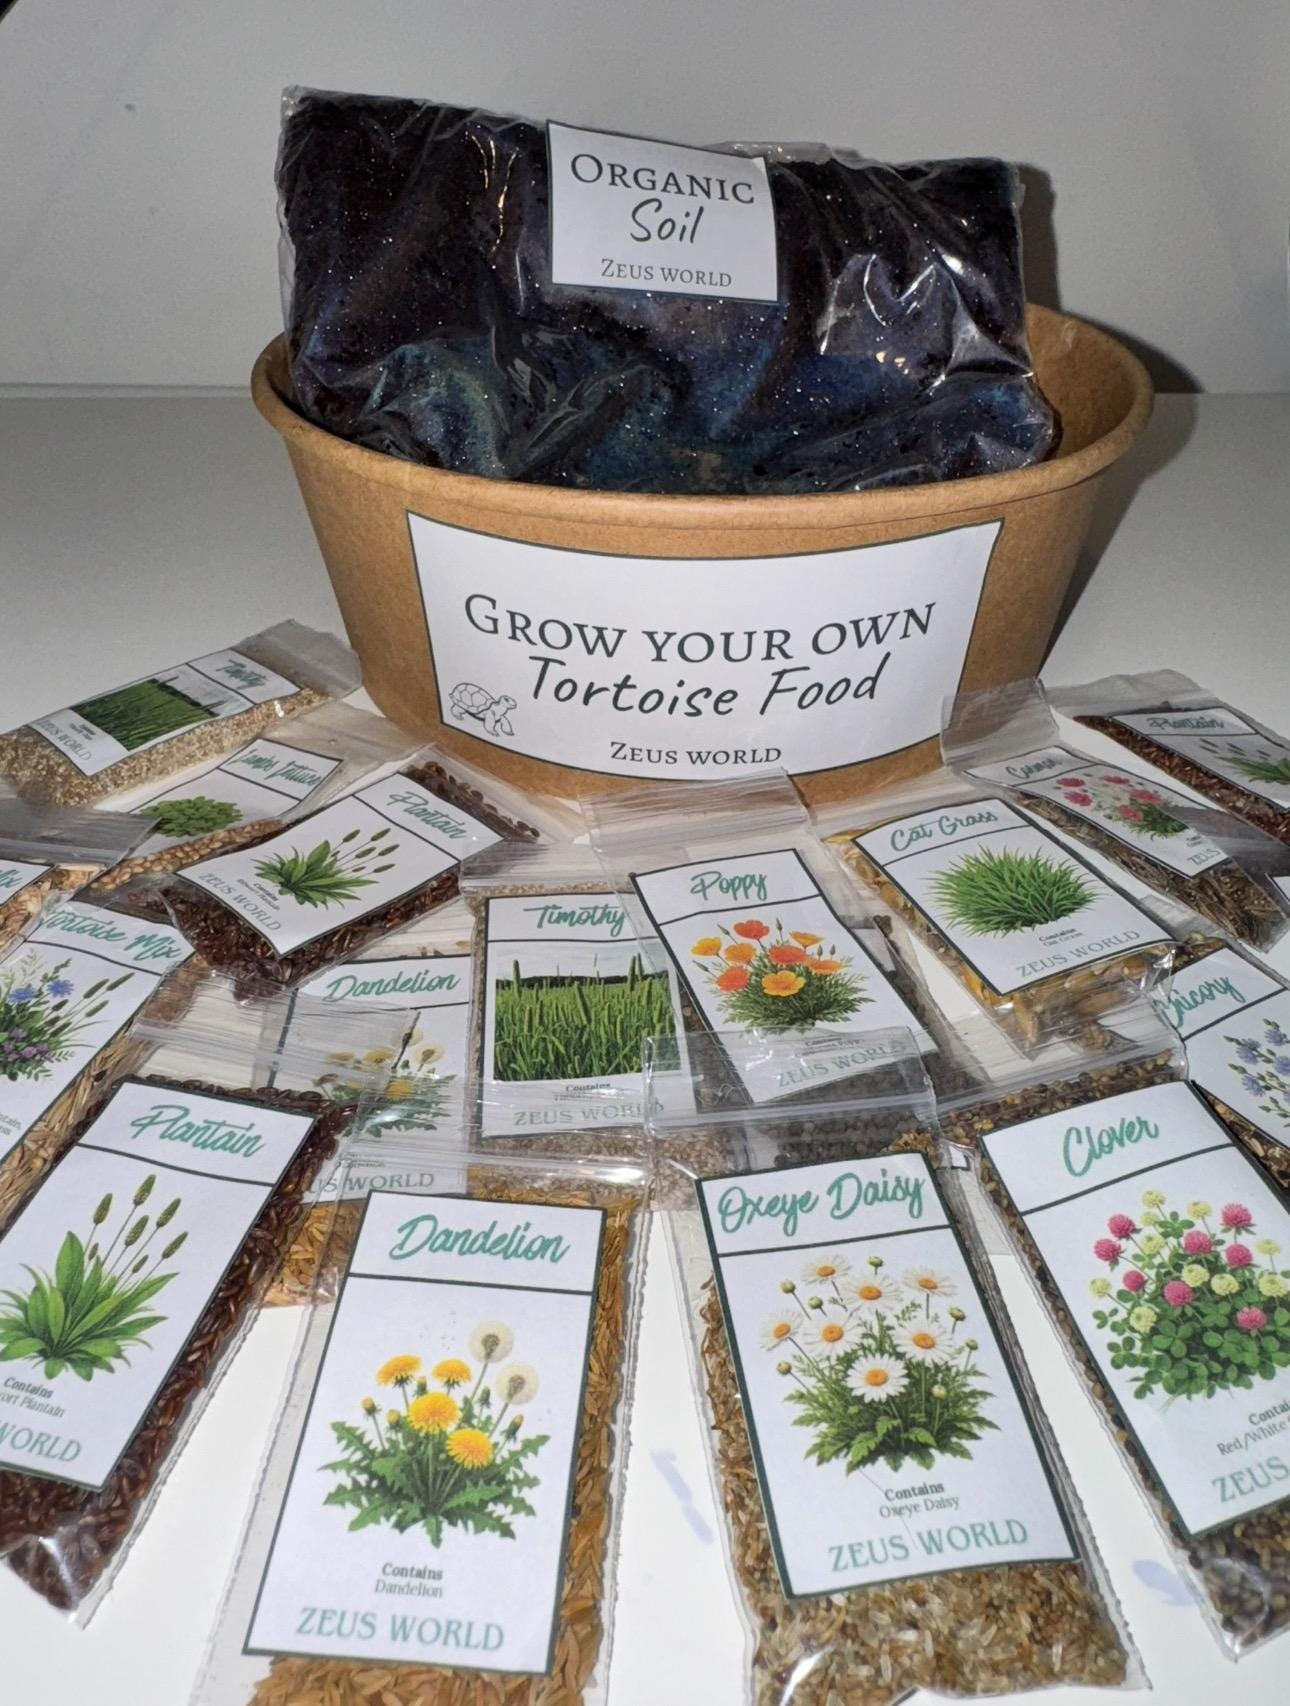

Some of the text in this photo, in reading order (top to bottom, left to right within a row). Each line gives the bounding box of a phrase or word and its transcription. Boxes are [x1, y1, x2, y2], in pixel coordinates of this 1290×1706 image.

[571, 153, 754, 204] ORGANIC
[630, 198, 704, 244] Soil
[601, 258, 732, 288] ZEUS WORLD
[464, 594, 936, 663] GROW YOUR OWN
[528, 651, 891, 717] Tortoise Food
[610, 741, 782, 766] ZEUS WORLD
[386, 791, 467, 838] Plantain
[890, 811, 998, 851] Cat Grass
[199, 873, 281, 930] ZEUS WORLD
[690, 871, 767, 900] Poppy
[523, 904, 627, 937] Timothy
[124, 933, 182, 961] Mix
[1016, 954, 1068, 978] ZEUS
[1069, 930, 1140, 958] WORLD
[323, 968, 461, 1002] Dandelion
[778, 1063, 829, 1087] ZEUS
[130, 1104, 266, 1158] Plantain
[514, 1110, 573, 1126] ZEUS
[1063, 1116, 1160, 1177] Clover
[348, 1173, 435, 1191] WORLD
[718, 1167, 925, 1237] Oxeye Daisy
[388, 1213, 571, 1264] Dandelion
[4, 1377, 54, 1399] Contains
[20, 1396, 65, 1418] Plantain
[1248, 1400, 1290, 1426] Contai
[1217, 1421, 1287, 1456] Red/White
[884, 1482, 945, 1500] Contains
[1211, 1456, 1290, 1503] ZEUS
[879, 1496, 960, 1519] Oxeye Daisy
[828, 1519, 1029, 1572] ZEUS WORLD
[374, 1579, 444, 1598] Dandelion
[382, 1563, 444, 1581] Contains
[296, 1607, 505, 1652] ZEUS WORLD
